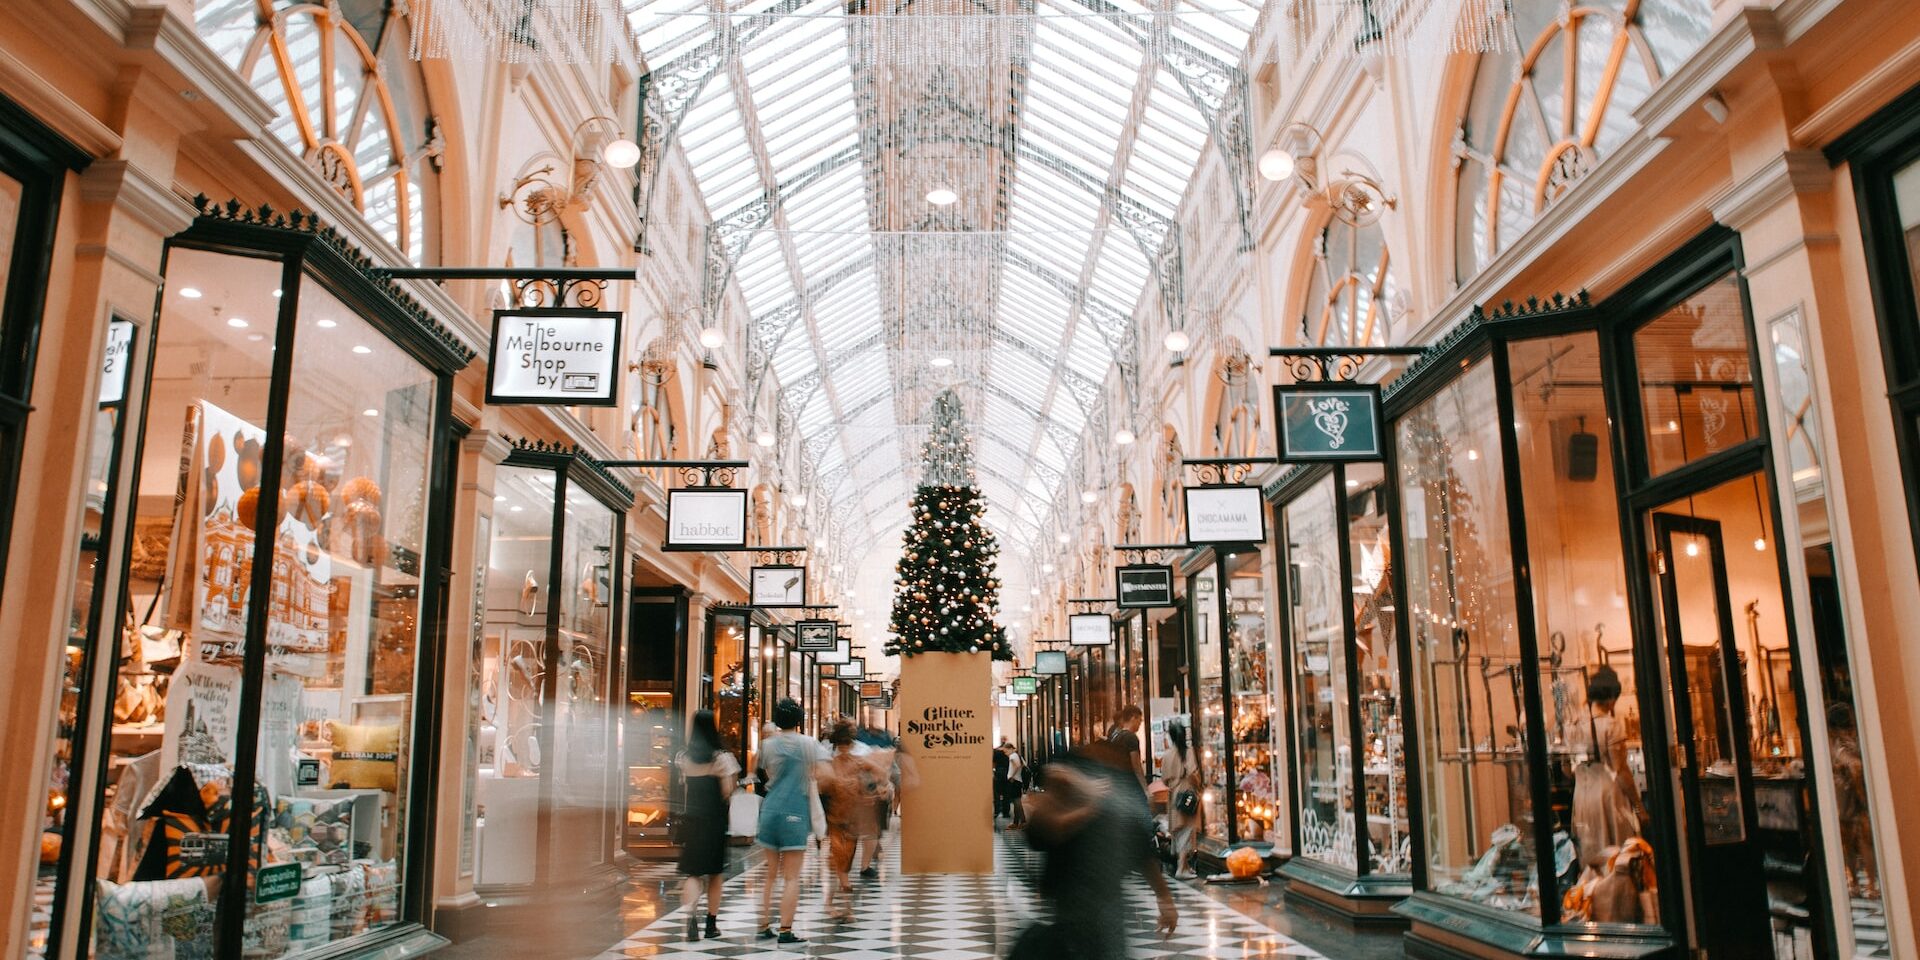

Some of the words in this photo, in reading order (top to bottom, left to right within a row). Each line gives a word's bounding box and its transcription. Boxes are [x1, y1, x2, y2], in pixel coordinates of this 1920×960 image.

[525, 322, 556, 337] The
[506, 336, 604, 352] Melbourne
[520, 353, 566, 373] Shop
[537, 374, 558, 389] by
[1197, 512, 1248, 524] CHOCAMAMA
[680, 522, 734, 537] habbot.
[923, 706, 975, 721] Glitter.
[907, 719, 963, 735] Sparkle
[923, 733, 941, 749] &
[942, 732, 985, 747] Shine
